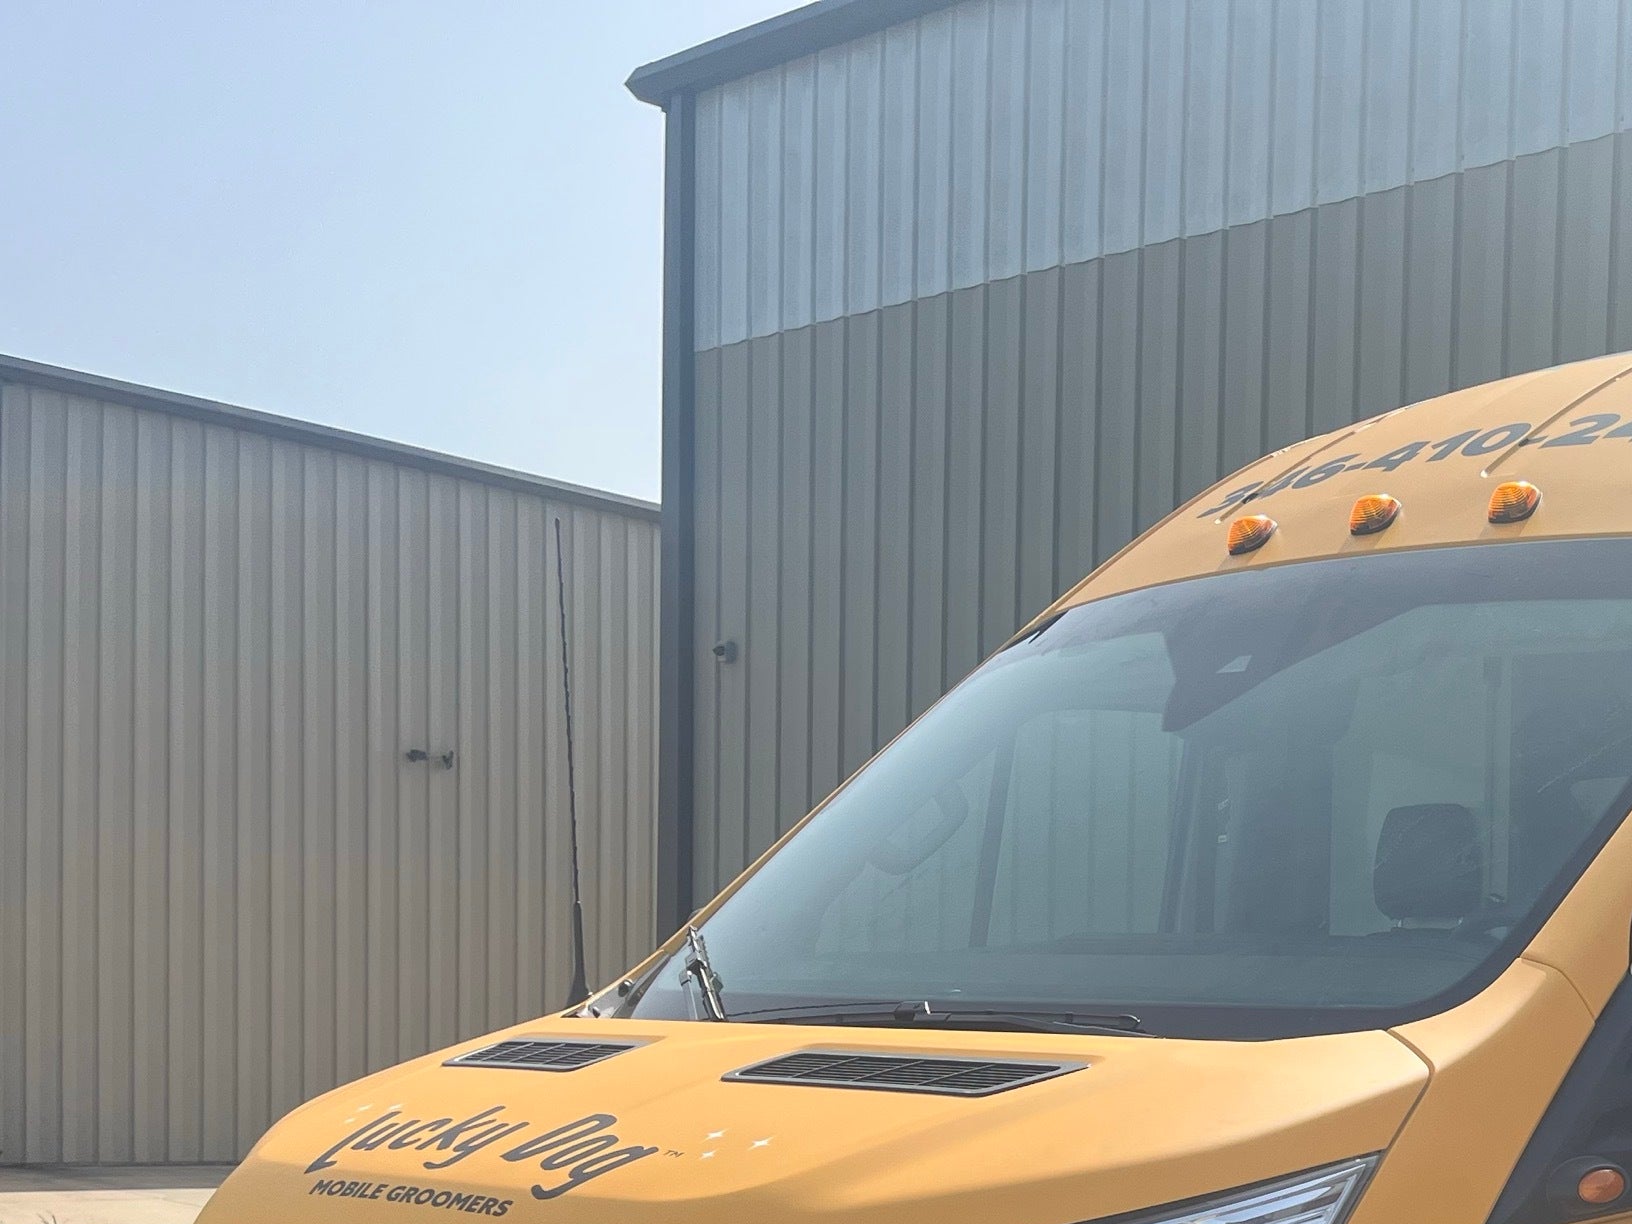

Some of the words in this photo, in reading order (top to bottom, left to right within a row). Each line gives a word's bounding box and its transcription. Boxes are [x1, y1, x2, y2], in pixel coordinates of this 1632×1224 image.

[303, 1105, 530, 1175] Lucky
[500, 1113, 660, 1200] Dog
[308, 1179, 388, 1200] MOBILE
[386, 1185, 514, 1217] GROOMERS
